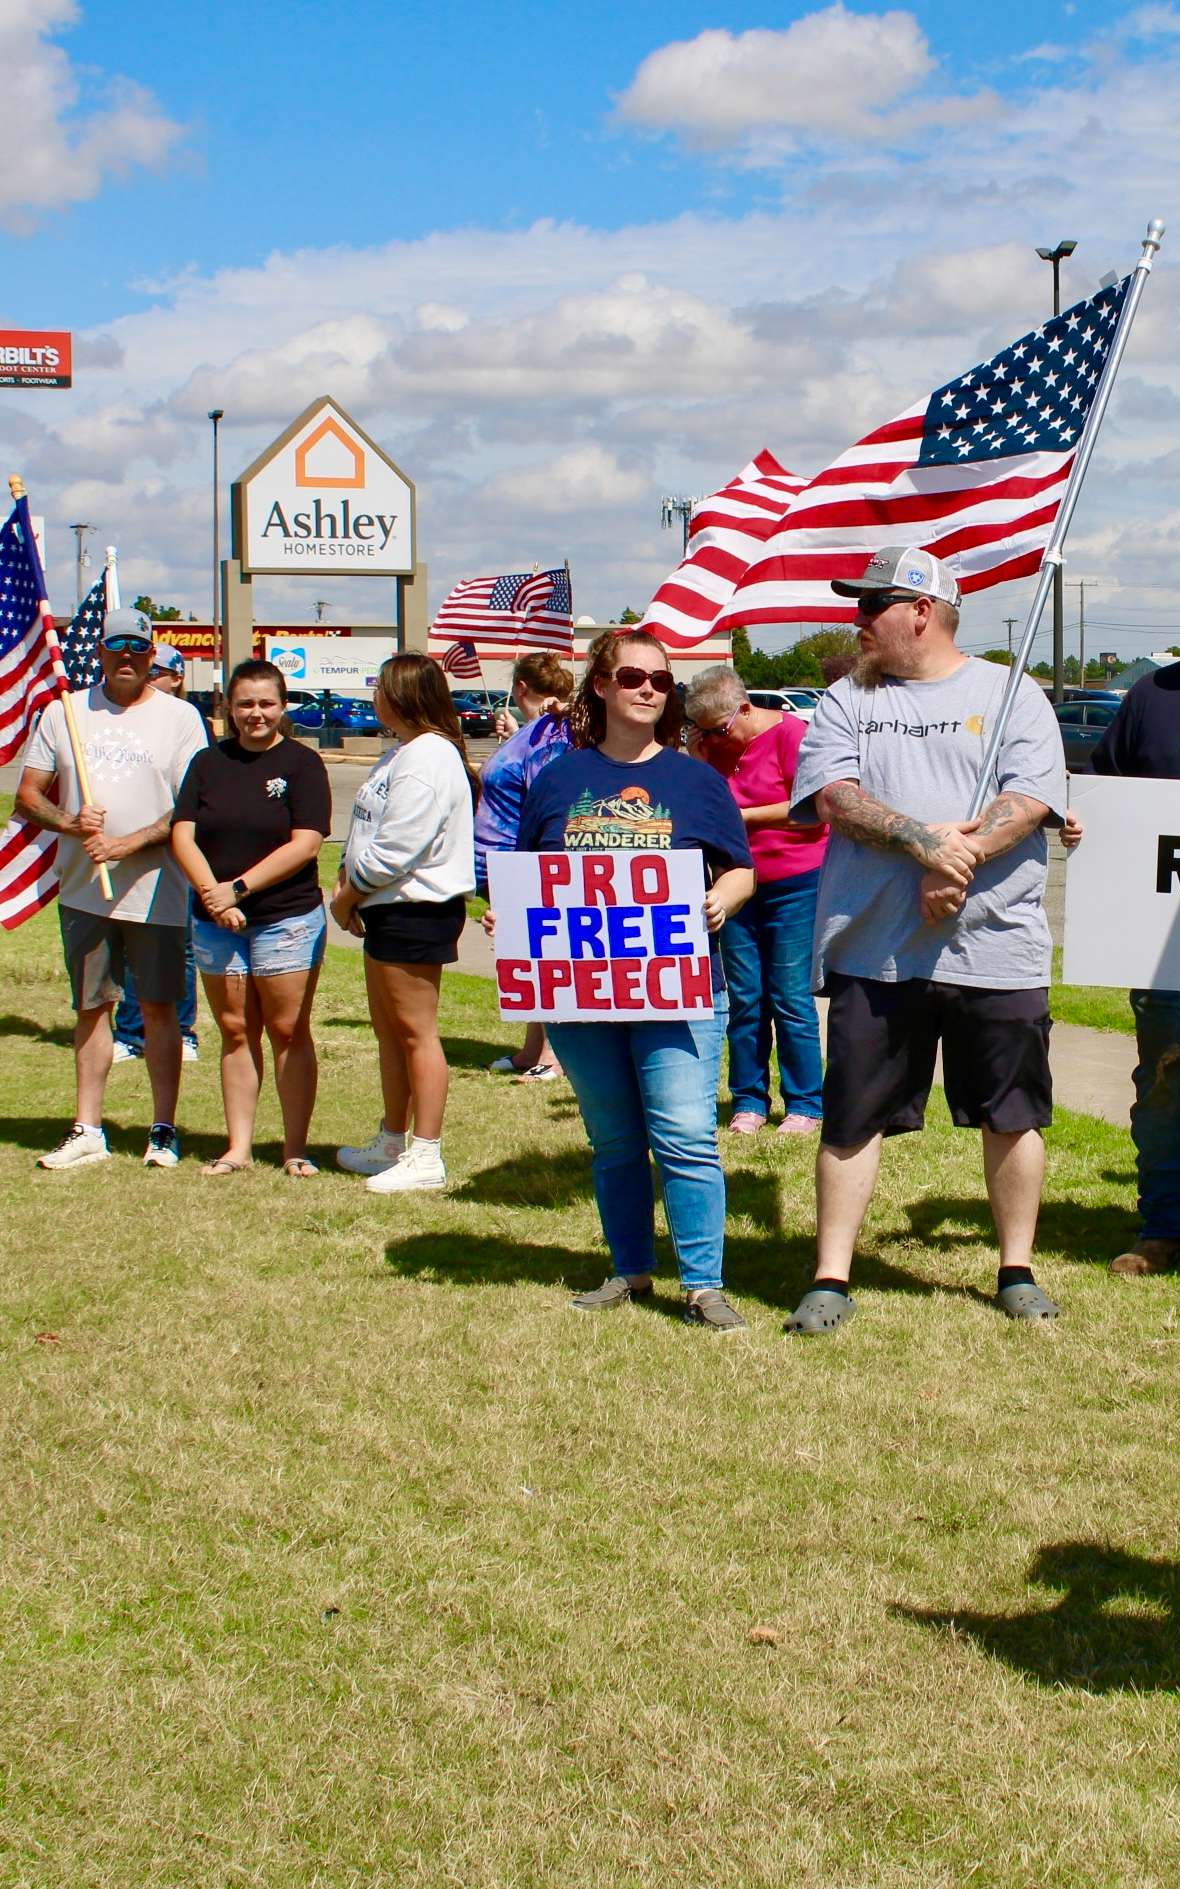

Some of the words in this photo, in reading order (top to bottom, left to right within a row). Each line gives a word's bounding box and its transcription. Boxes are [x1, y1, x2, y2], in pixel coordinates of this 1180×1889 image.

[21, 366, 56, 374] CENTER
[261, 498, 398, 551] Ashley
[284, 543, 375, 556] HOMESTORE
[563, 831, 671, 849] WANDERER
[538, 854, 670, 908] PRO
[526, 904, 695, 960] FREE
[496, 956, 714, 1011] SPEECH
